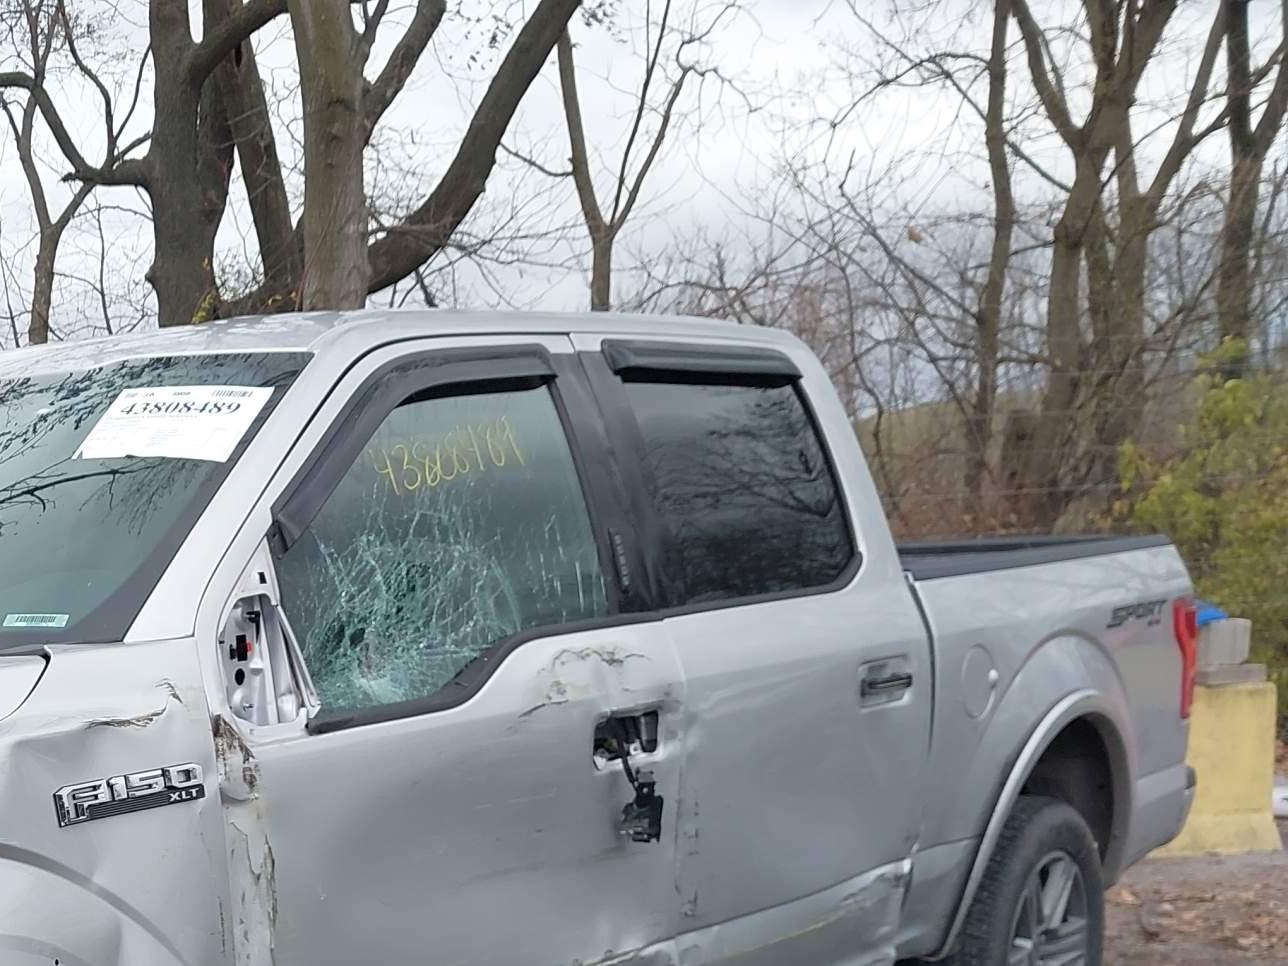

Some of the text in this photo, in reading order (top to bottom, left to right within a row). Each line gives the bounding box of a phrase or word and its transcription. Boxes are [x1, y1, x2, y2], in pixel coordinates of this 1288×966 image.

[120, 400, 242, 415] 43808489
[1106, 599, 1168, 629] SPORT
[168, 787, 201, 802] XLT
